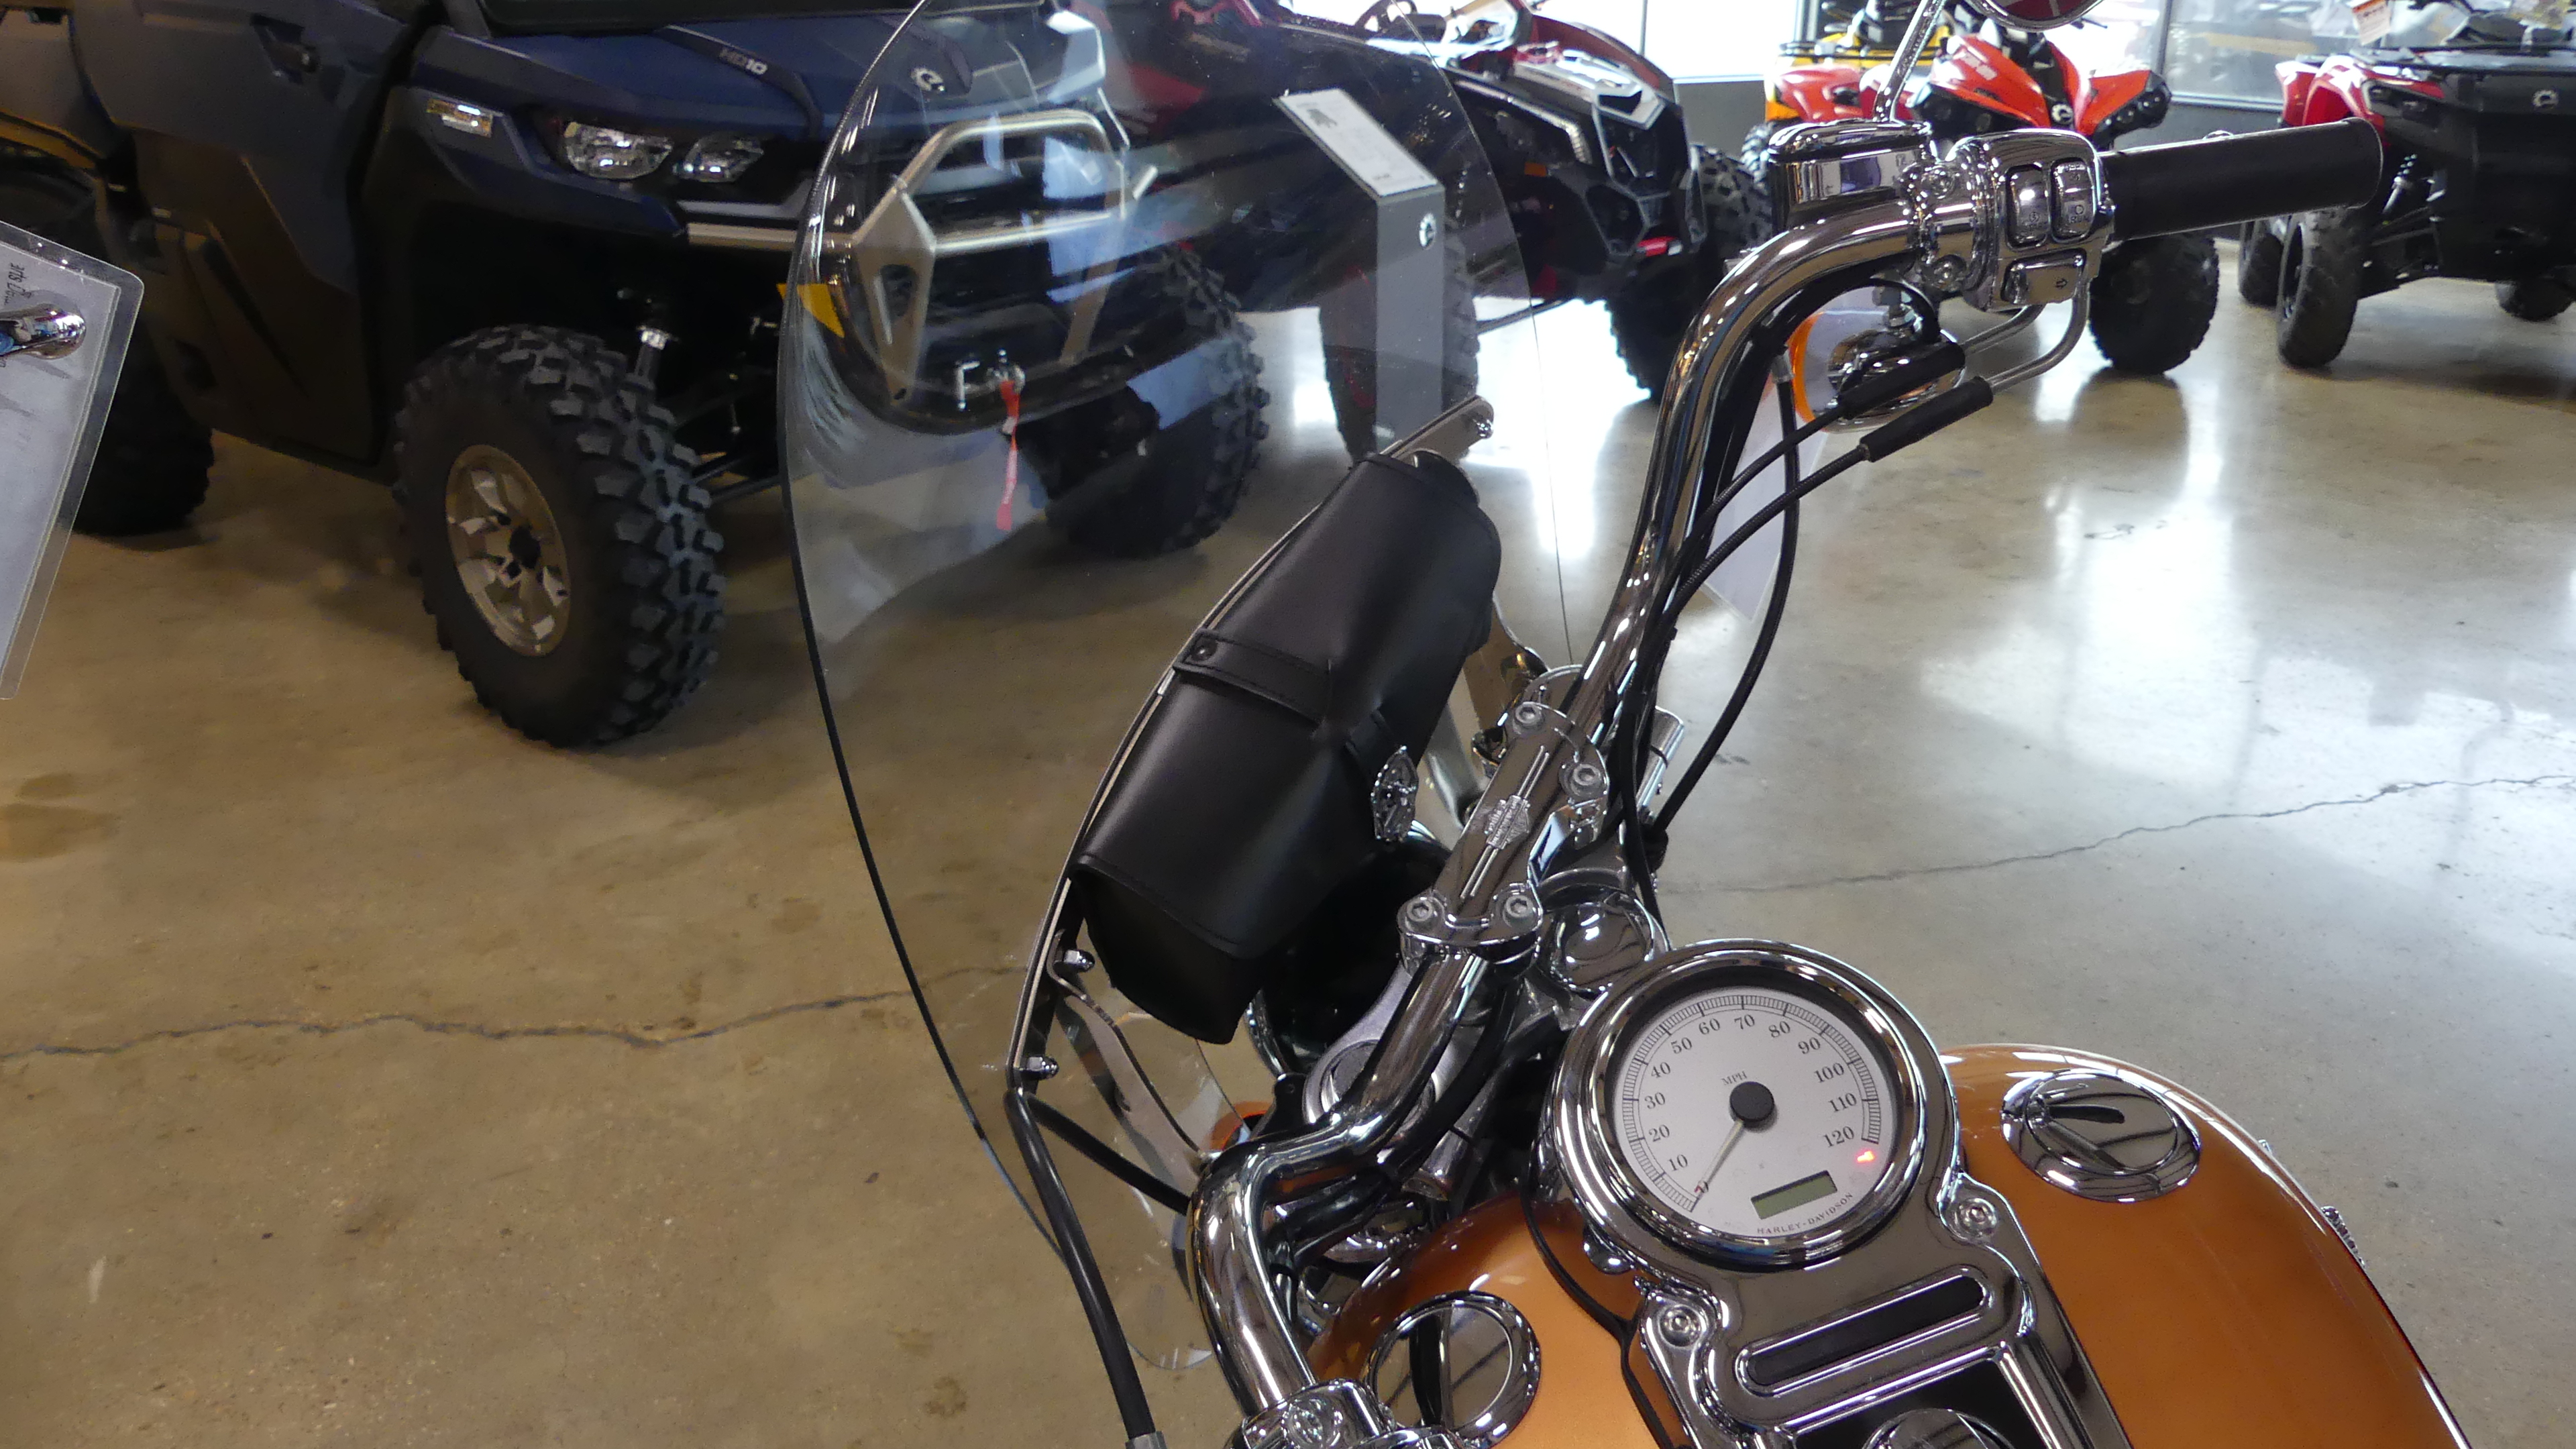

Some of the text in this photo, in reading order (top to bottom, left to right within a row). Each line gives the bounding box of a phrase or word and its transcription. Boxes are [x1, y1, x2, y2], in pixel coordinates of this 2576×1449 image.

[1699, 1018, 1721, 1035] 60
[1734, 1014, 1756, 1030] 70
[1768, 1020, 1790, 1038] 80
[1670, 1037, 1693, 1054] 50
[1798, 1037, 1821, 1055] 90
[1651, 1061, 1671, 1078] 40
[1721, 1071, 1748, 1085] MPH
[1814, 1063, 1845, 1083] 100
[1644, 1092, 1666, 1109] 30
[1828, 1093, 1857, 1113] 110
[1648, 1124, 1670, 1142] 20
[1823, 1126, 1854, 1148] 120
[1668, 1154, 1688, 1171] 10
[1757, 1191, 1854, 1234] HARLEY-DAVIDSON
